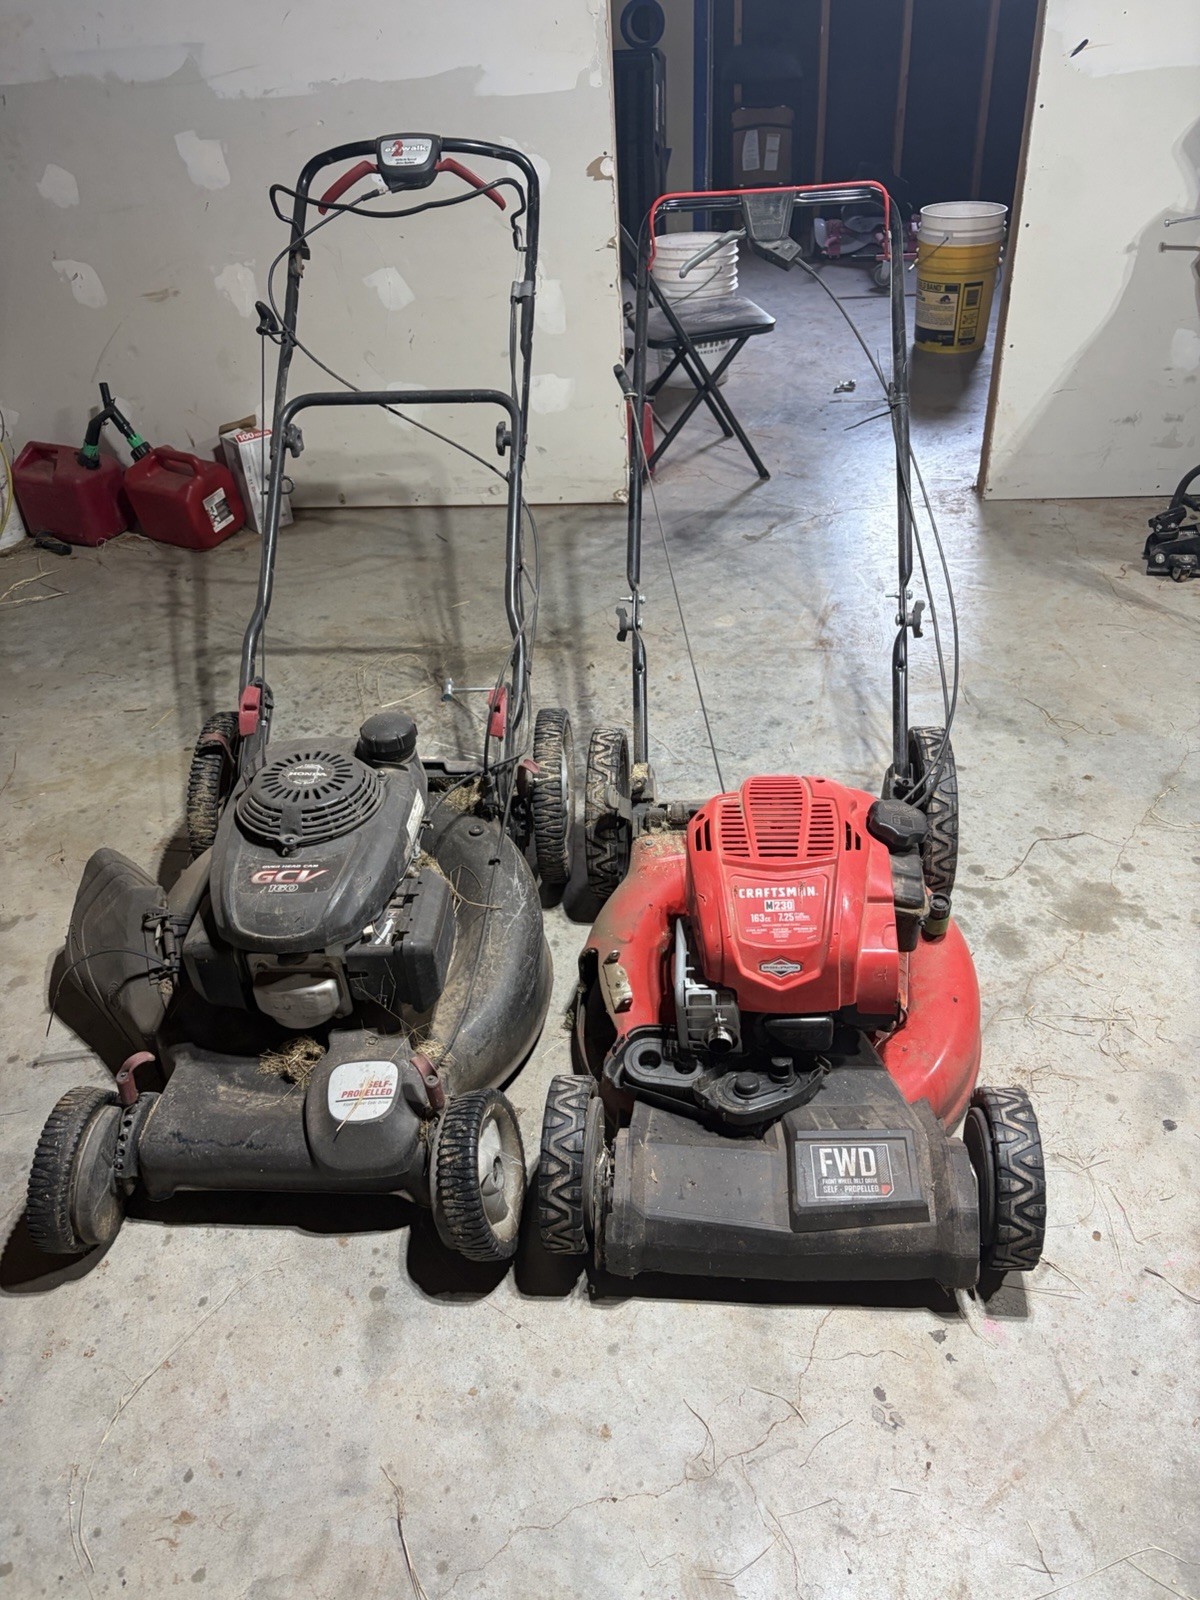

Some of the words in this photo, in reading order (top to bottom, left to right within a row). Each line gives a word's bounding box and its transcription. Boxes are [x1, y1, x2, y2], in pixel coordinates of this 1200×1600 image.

[238, 431, 255, 441] 100
[251, 869, 330, 884] GCV
[268, 884, 299, 893] 160
[765, 900, 794, 911] M230
[778, 912, 794, 922] 7.25
[819, 1147, 877, 1177] FWD
[823, 1185, 838, 1193] SELF
[844, 1185, 879, 1193] PROPELLED
